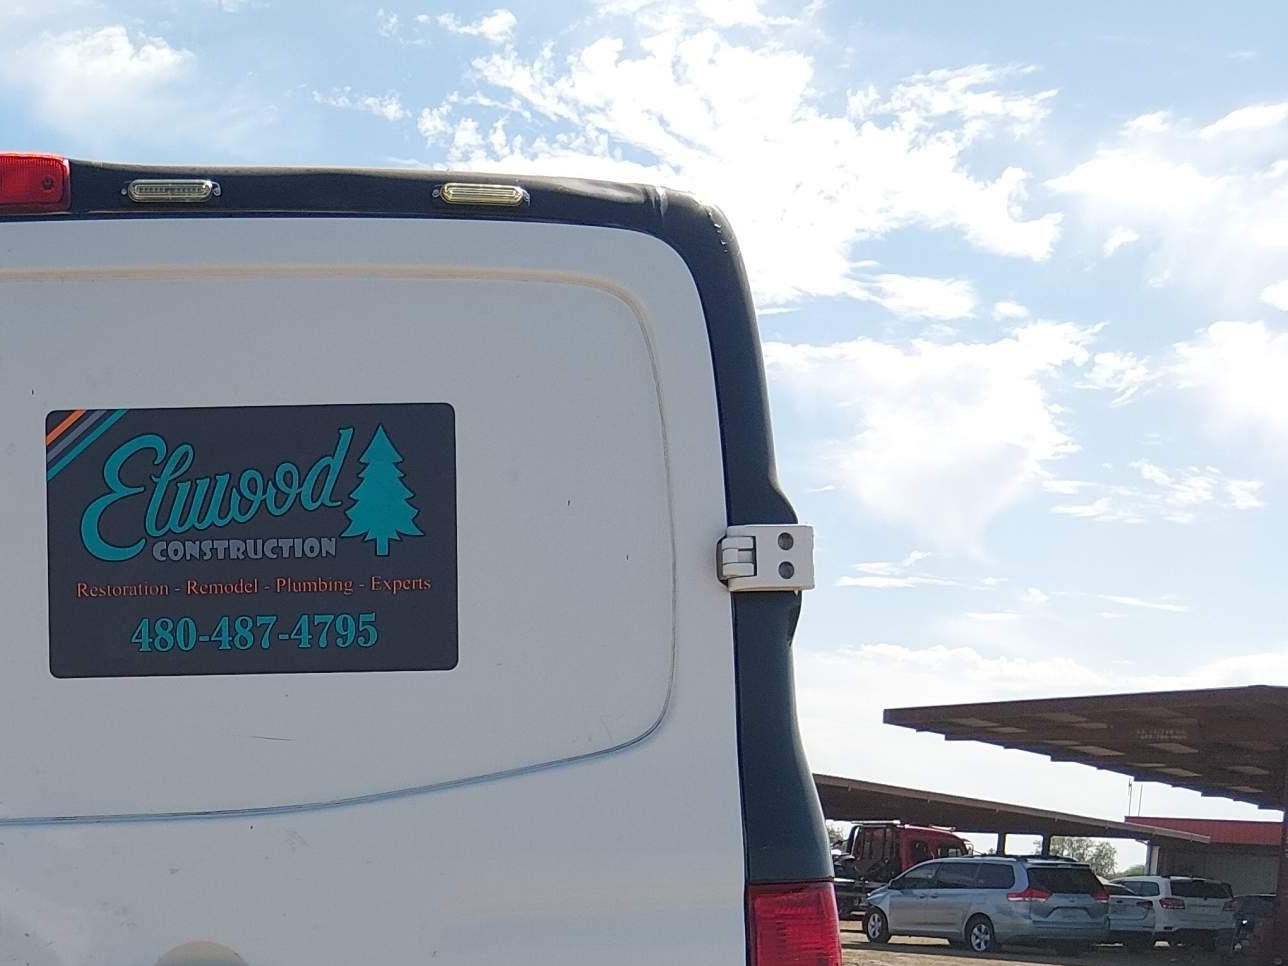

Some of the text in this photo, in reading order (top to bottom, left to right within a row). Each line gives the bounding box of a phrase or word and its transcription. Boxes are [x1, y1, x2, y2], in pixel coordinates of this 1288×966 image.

[80, 426, 354, 561] Elwood
[152, 537, 337, 561] CONSTRUCTION
[76, 580, 169, 598] Restoration
[185, 578, 259, 596] Remodel
[276, 576, 354, 596] Plumbing
[370, 575, 432, 595] Experts
[131, 612, 379, 653] 480-487-4795
